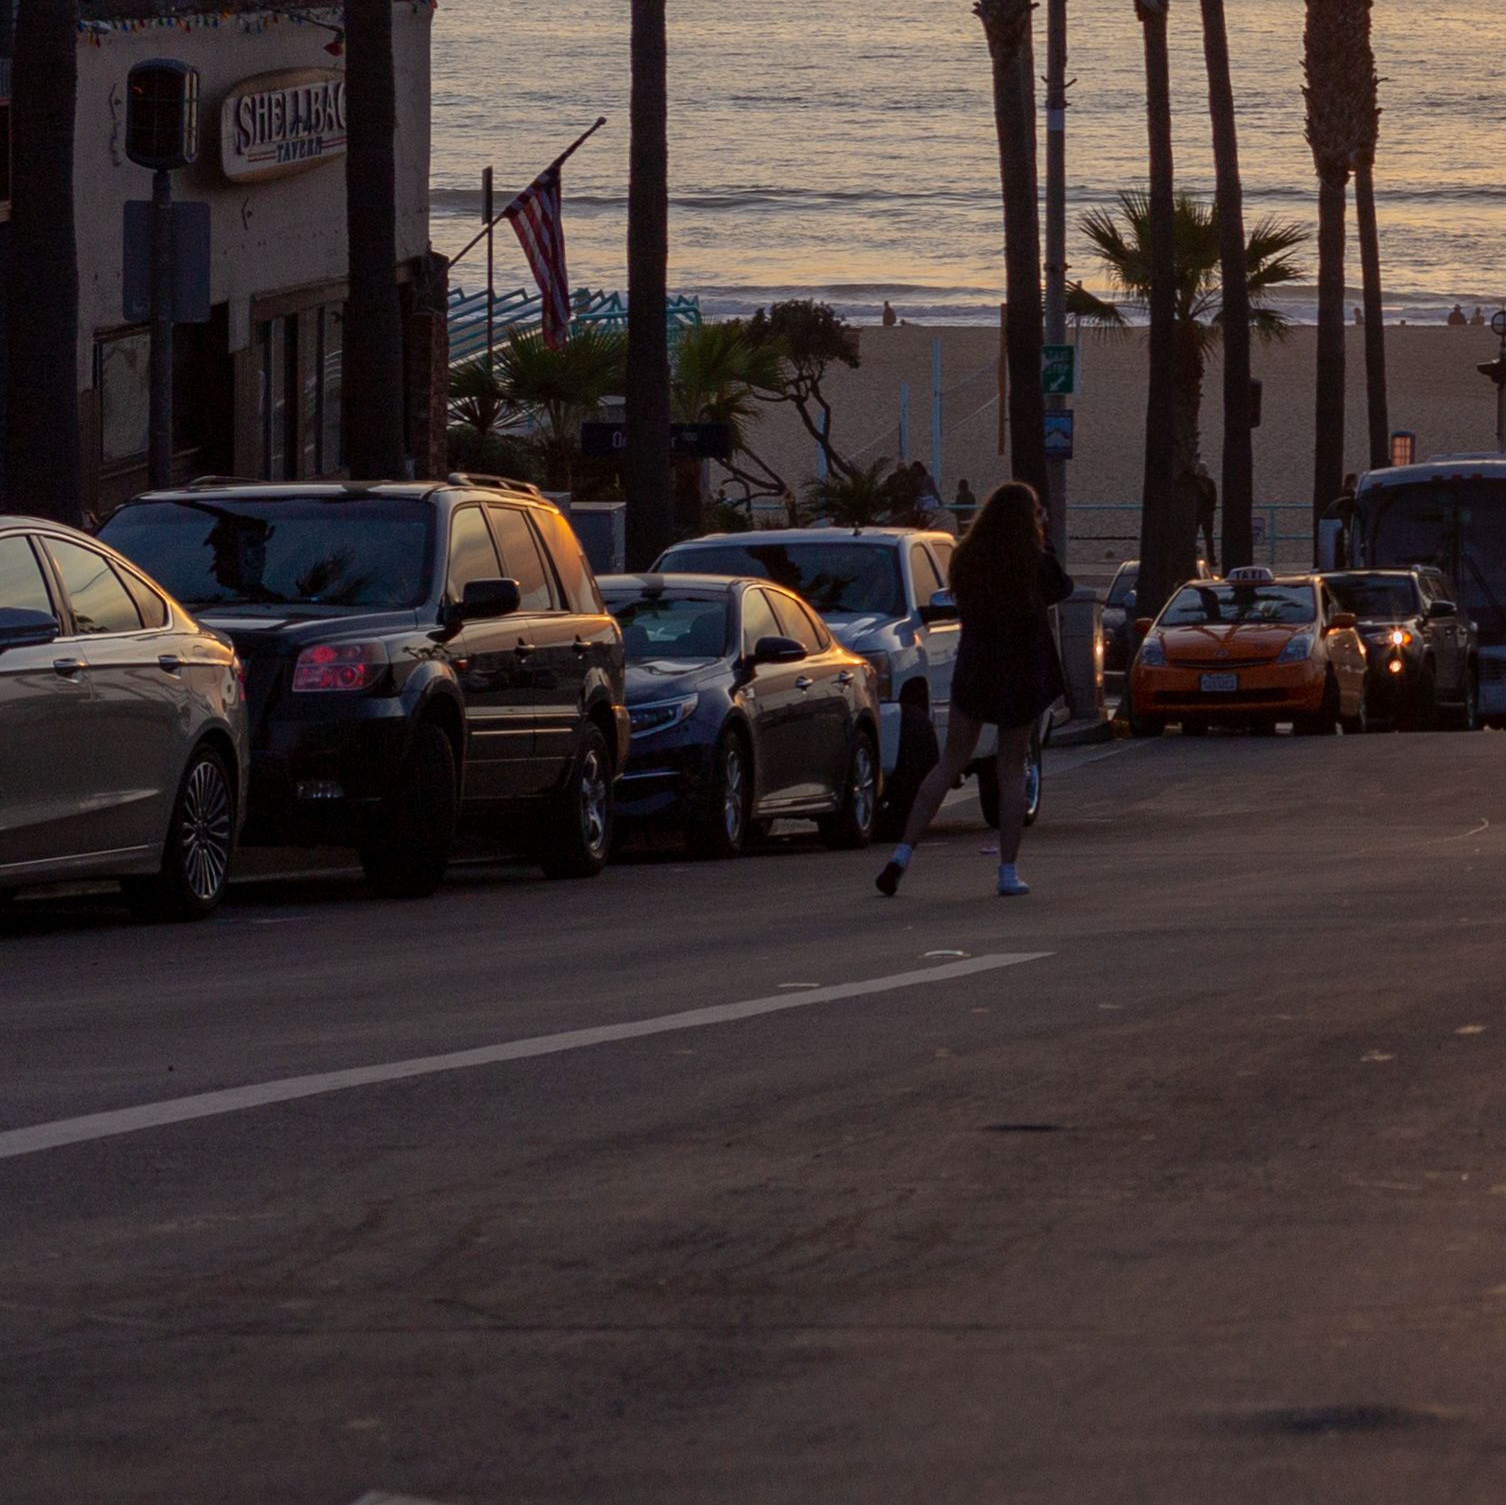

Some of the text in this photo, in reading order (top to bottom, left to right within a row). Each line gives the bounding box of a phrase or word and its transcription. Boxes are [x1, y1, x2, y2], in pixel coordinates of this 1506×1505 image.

[236, 81, 346, 156] SHELLBAC
[277, 137, 323, 162] TAVERN
[1235, 570, 1262, 579] TAXI
